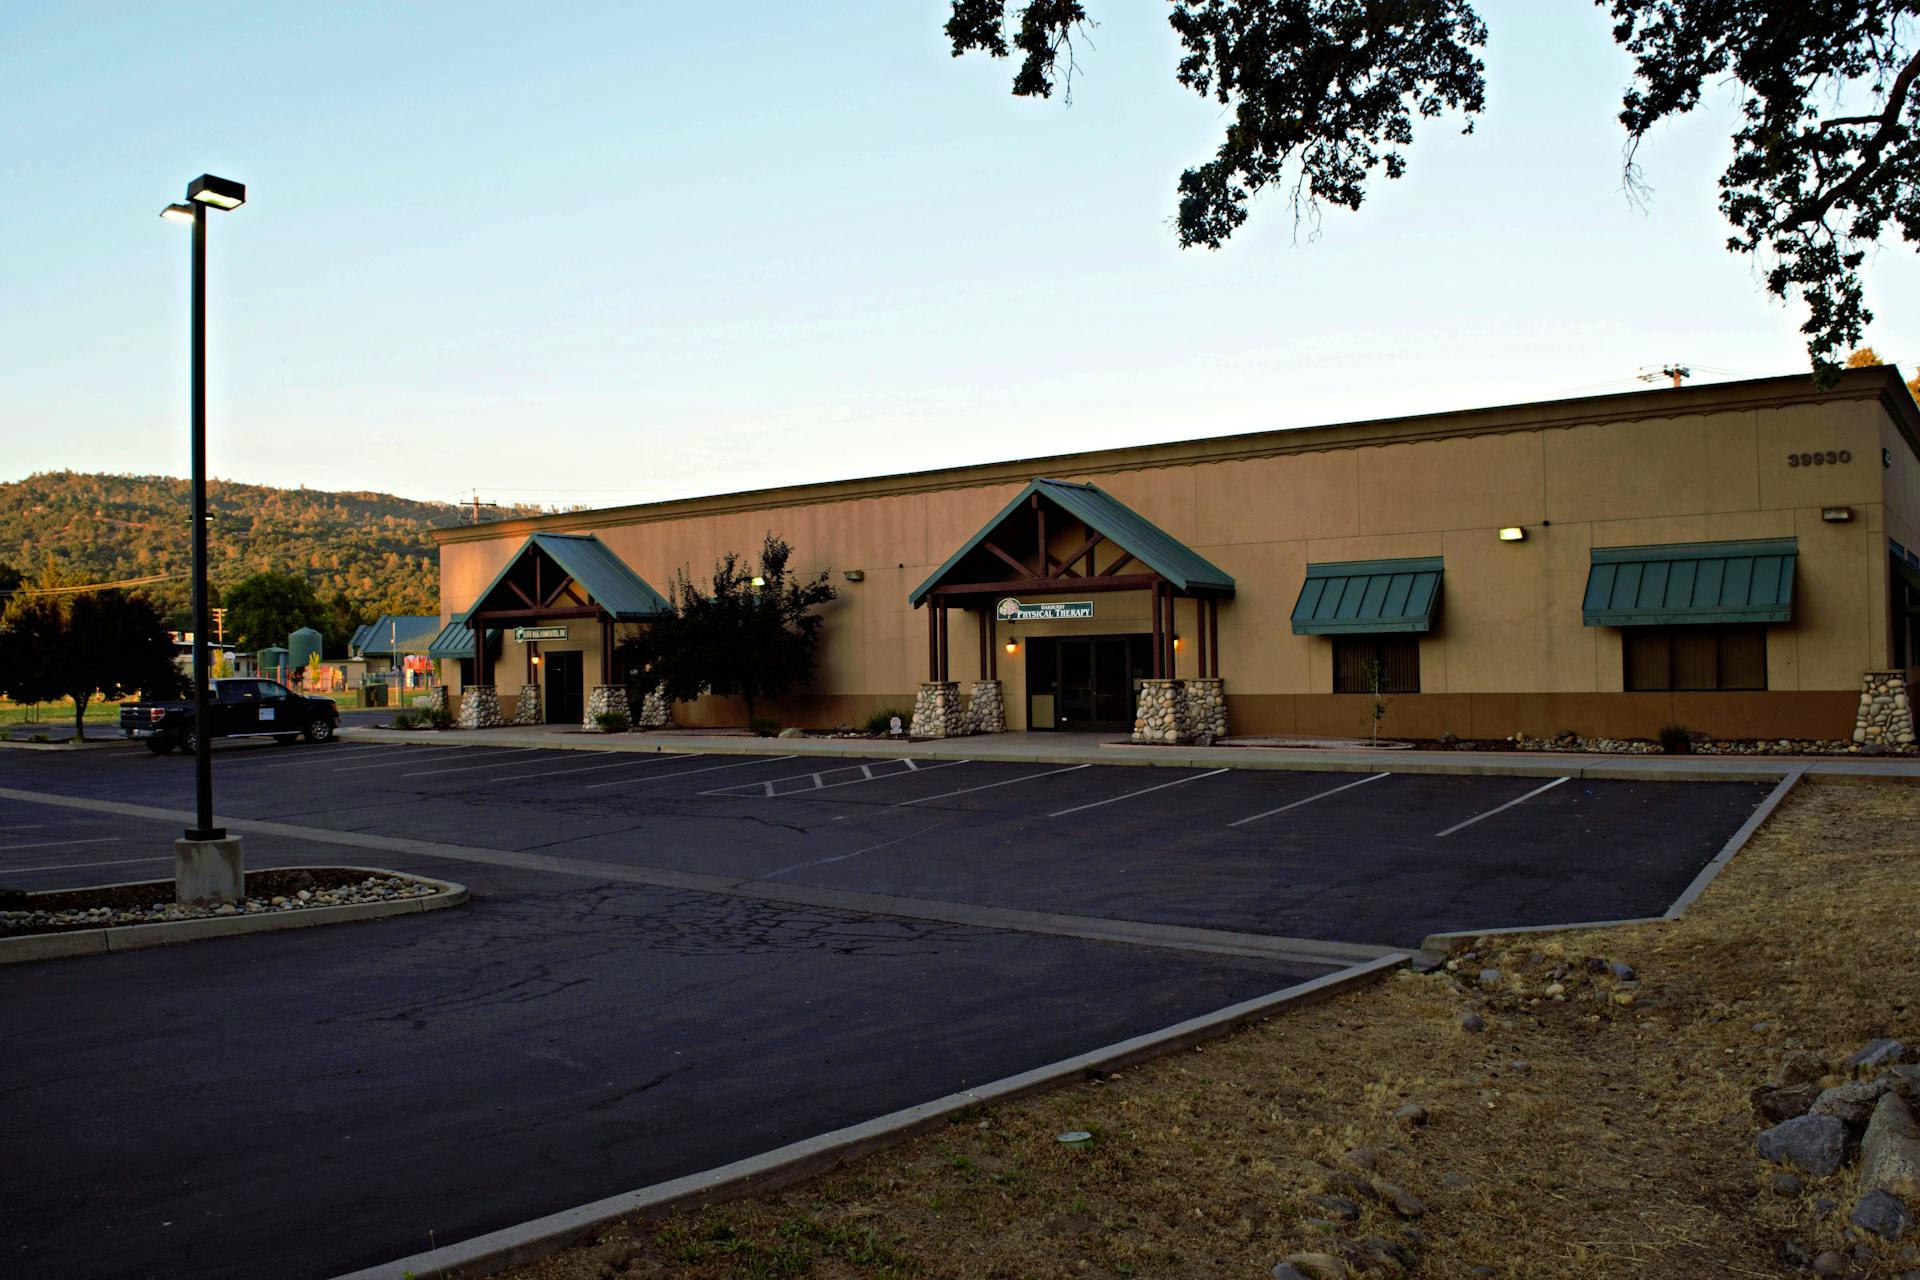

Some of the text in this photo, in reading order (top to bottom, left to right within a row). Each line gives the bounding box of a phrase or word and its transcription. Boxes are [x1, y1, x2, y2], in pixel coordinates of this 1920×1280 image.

[1787, 450, 1852, 468] 39930
[1017, 609, 1090, 619] PHYSICAL THERAPY
